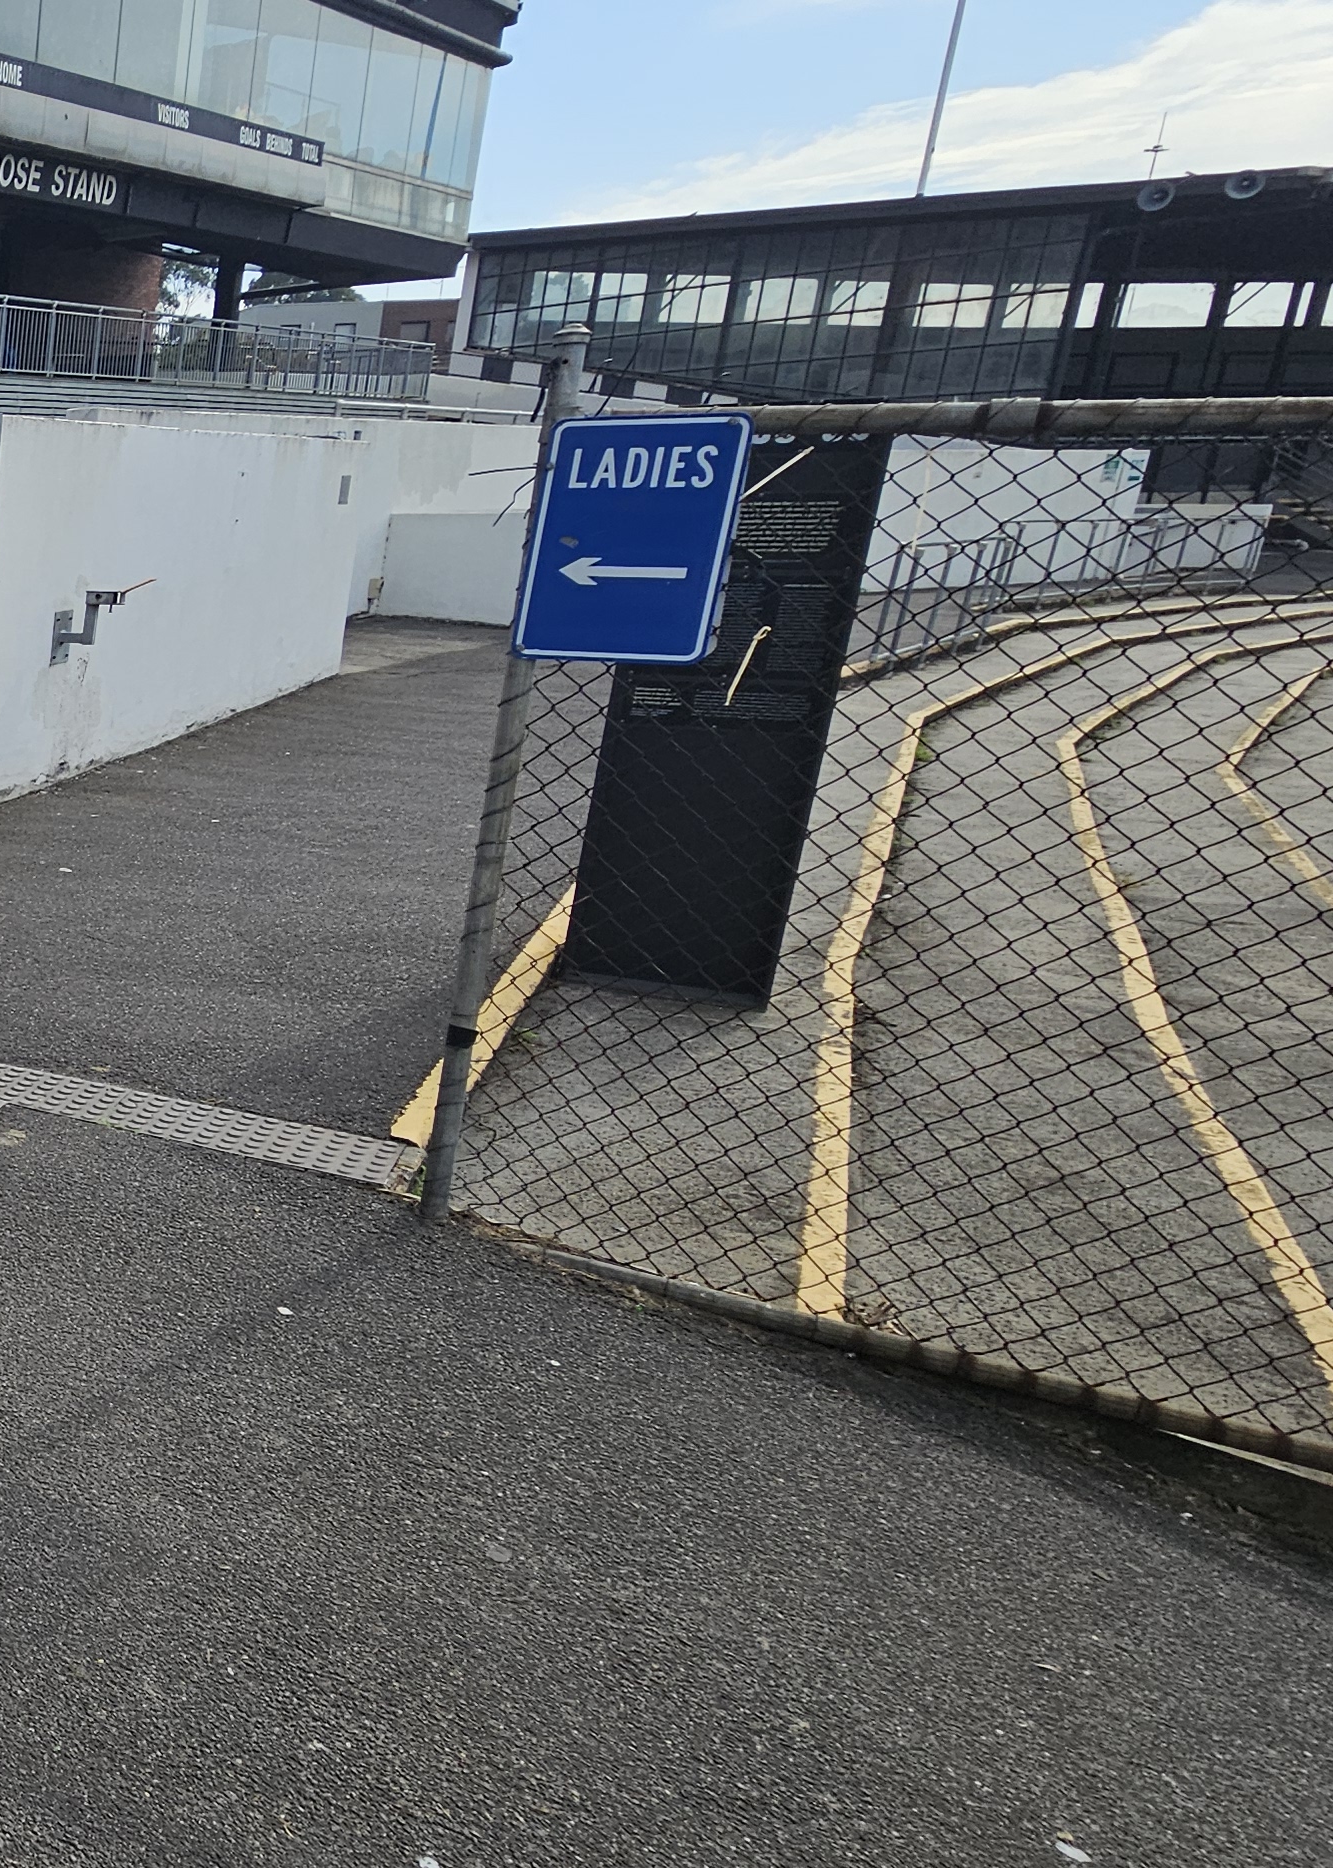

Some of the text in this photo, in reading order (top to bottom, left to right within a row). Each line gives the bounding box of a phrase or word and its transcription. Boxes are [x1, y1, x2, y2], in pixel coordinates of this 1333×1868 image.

[158, 102, 190, 129] VISITORS
[239, 125, 319, 163] GOALS BEHINDS TOTAL
[51, 165, 118, 206] STAND
[568, 445, 719, 488] LADIES
